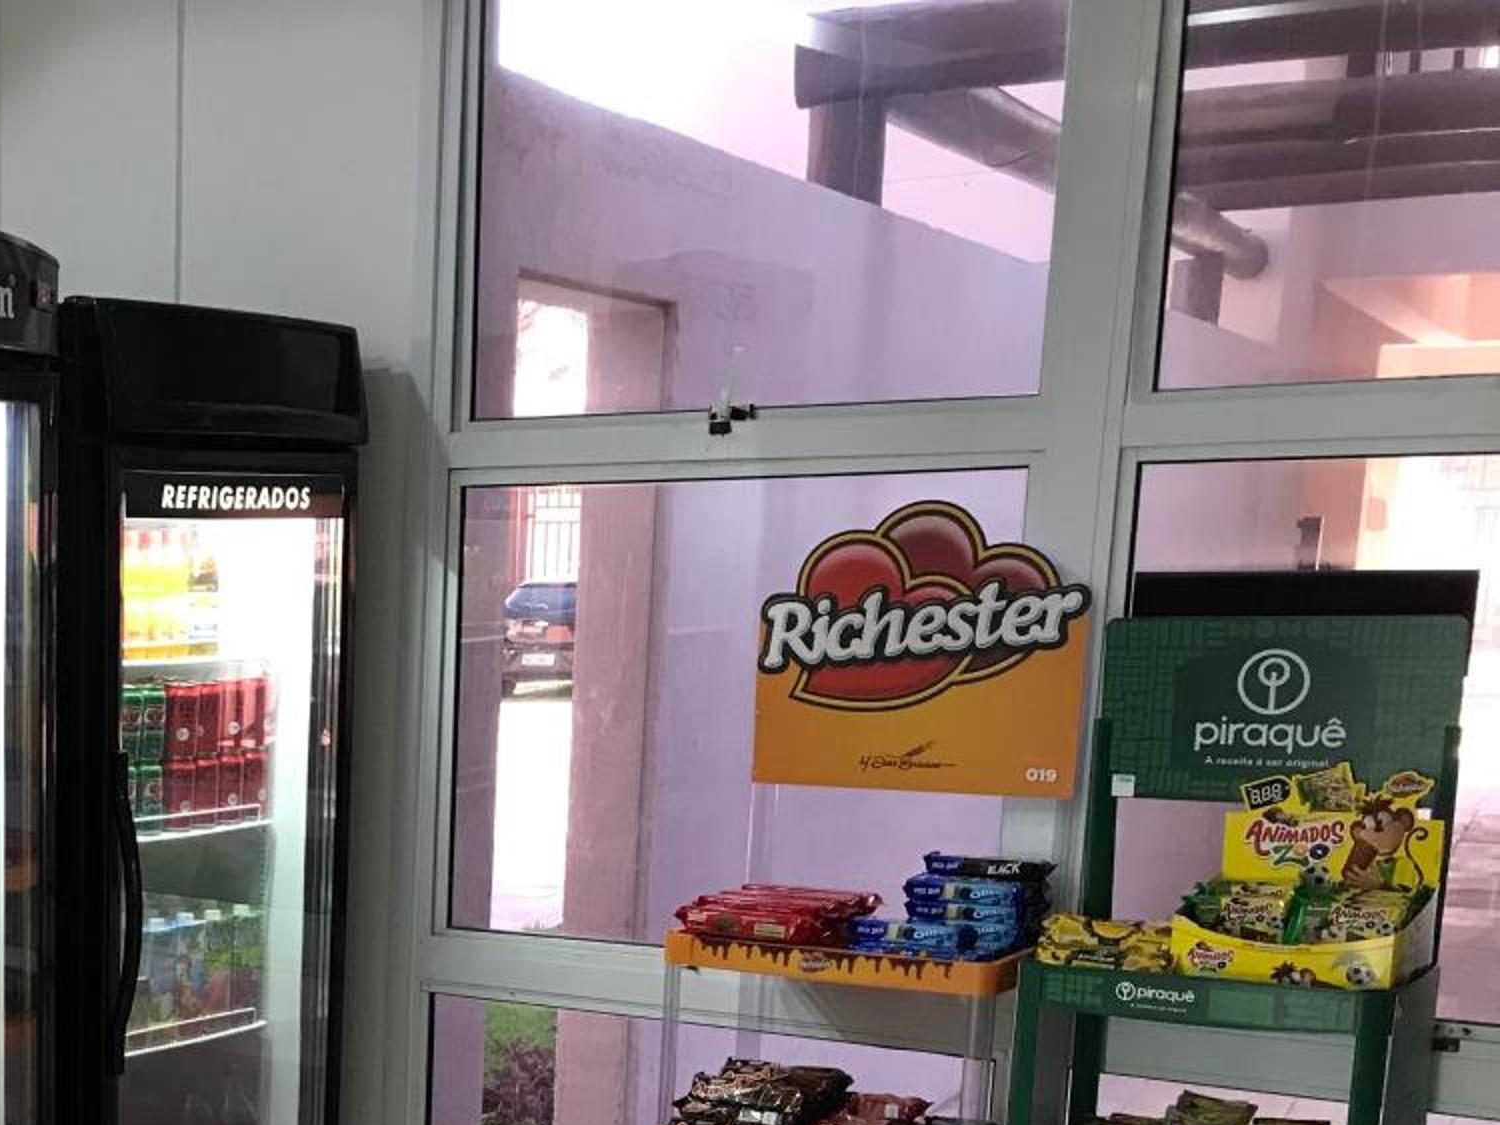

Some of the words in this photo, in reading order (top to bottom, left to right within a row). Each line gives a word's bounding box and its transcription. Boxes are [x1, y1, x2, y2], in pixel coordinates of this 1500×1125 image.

[161, 484, 312, 512] REFRIGERADOS
[762, 579, 1085, 671] Richester
[1193, 715, 1348, 755] piraquê
[1204, 754, 1214, 765] A
[1025, 767, 1058, 784] 019
[1246, 820, 1345, 857] ANIMADOS
[986, 862, 1021, 875] BLACK
[1136, 984, 1196, 1005] piraquê
